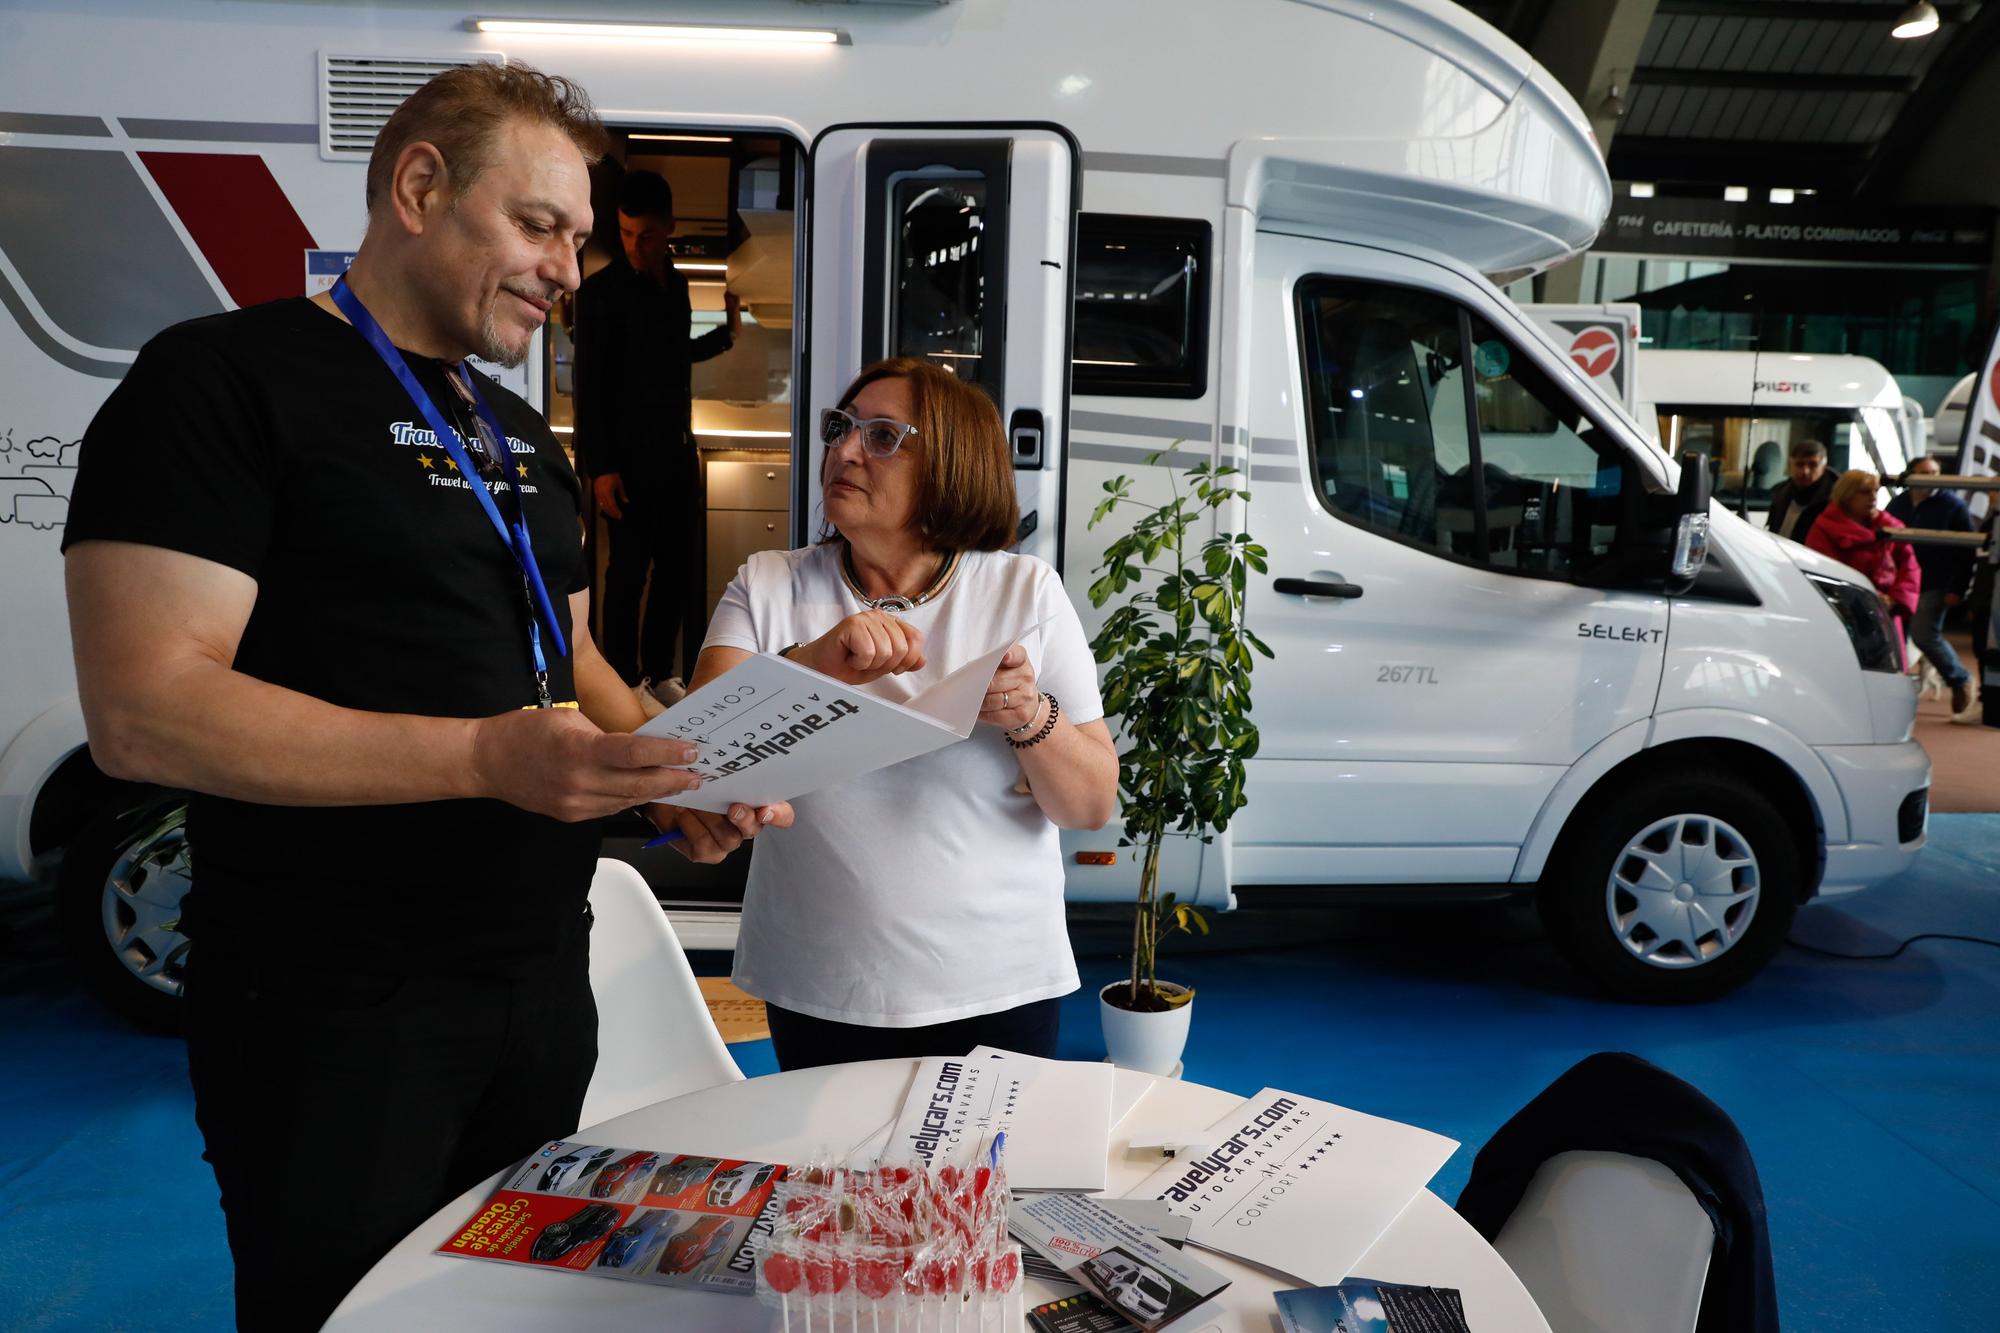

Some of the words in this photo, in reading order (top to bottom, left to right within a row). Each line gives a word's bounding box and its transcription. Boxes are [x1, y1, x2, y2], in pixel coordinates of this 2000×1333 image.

[1652, 220, 1734, 238] CAFETERÍA
[1745, 225, 1801, 240] PLATOS
[1803, 226, 1901, 243] COMBINADOS
[1754, 381, 1812, 393] PILOTE
[428, 473, 461, 488] Travel
[1578, 623, 1664, 643] SELEKT
[1377, 664, 1439, 684] 267TL
[667, 686, 756, 740] CONFORT
[702, 699, 860, 782] travelycars
[1188, 1110, 1310, 1212] UTOCARAVANAS
[1236, 1173, 1299, 1227] CONFORT
[452, 1203, 507, 1248] Ocasión
[486, 1199, 529, 1235] Coches
[496, 1212, 532, 1243] Selección
[521, 1226, 535, 1235] La
[470, 1236, 491, 1251] de
[487, 1243, 500, 1253] de
[502, 1234, 524, 1255] mejor
